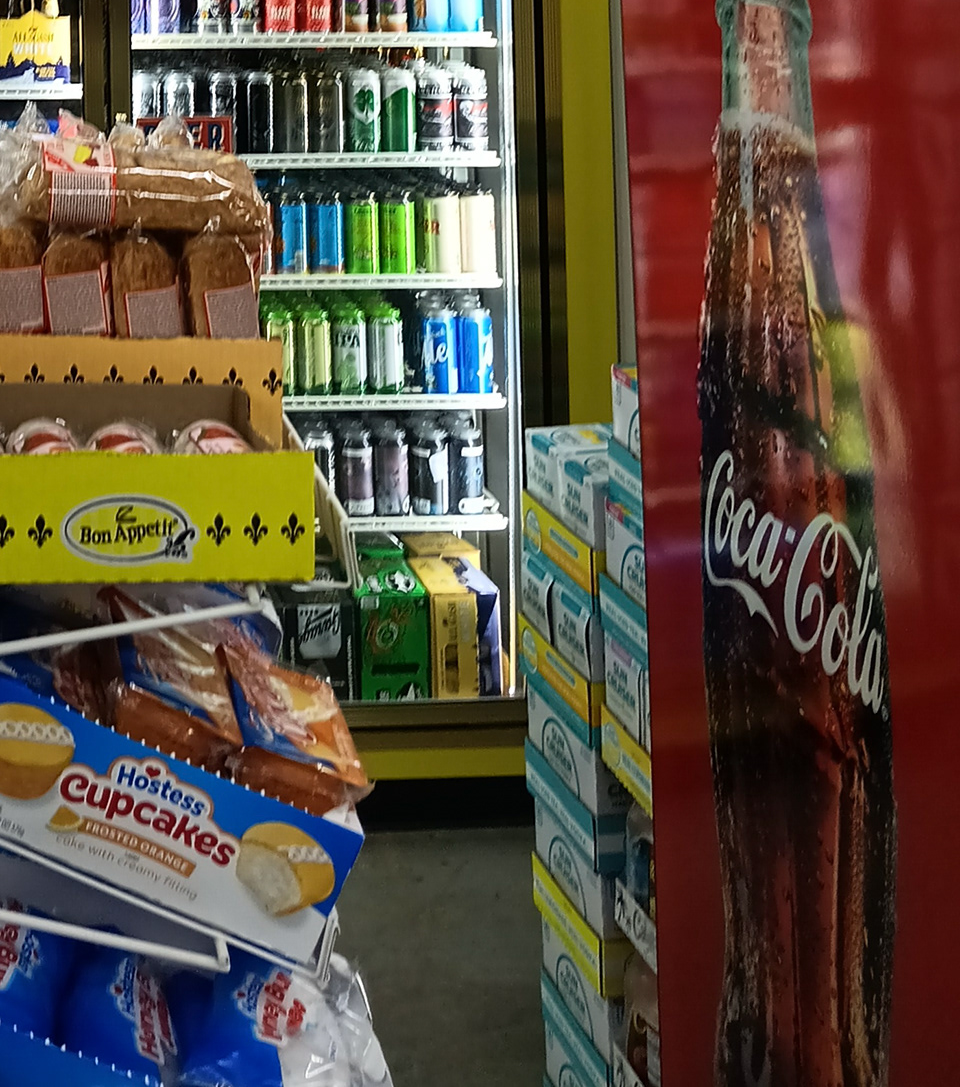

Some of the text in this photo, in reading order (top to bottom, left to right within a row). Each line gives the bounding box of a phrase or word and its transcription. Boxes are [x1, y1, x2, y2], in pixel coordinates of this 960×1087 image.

[80, 525, 112, 545] Bon
[704, 449, 886, 714] Coca-Cola
[116, 763, 207, 817] Hostess
[59, 773, 236, 867] Cupcakes
[85, 820, 190, 874] FROSTED ORANGE
[55, 833, 86, 852] cake
[88, 842, 115, 862] with
[117, 854, 162, 883] creamy
